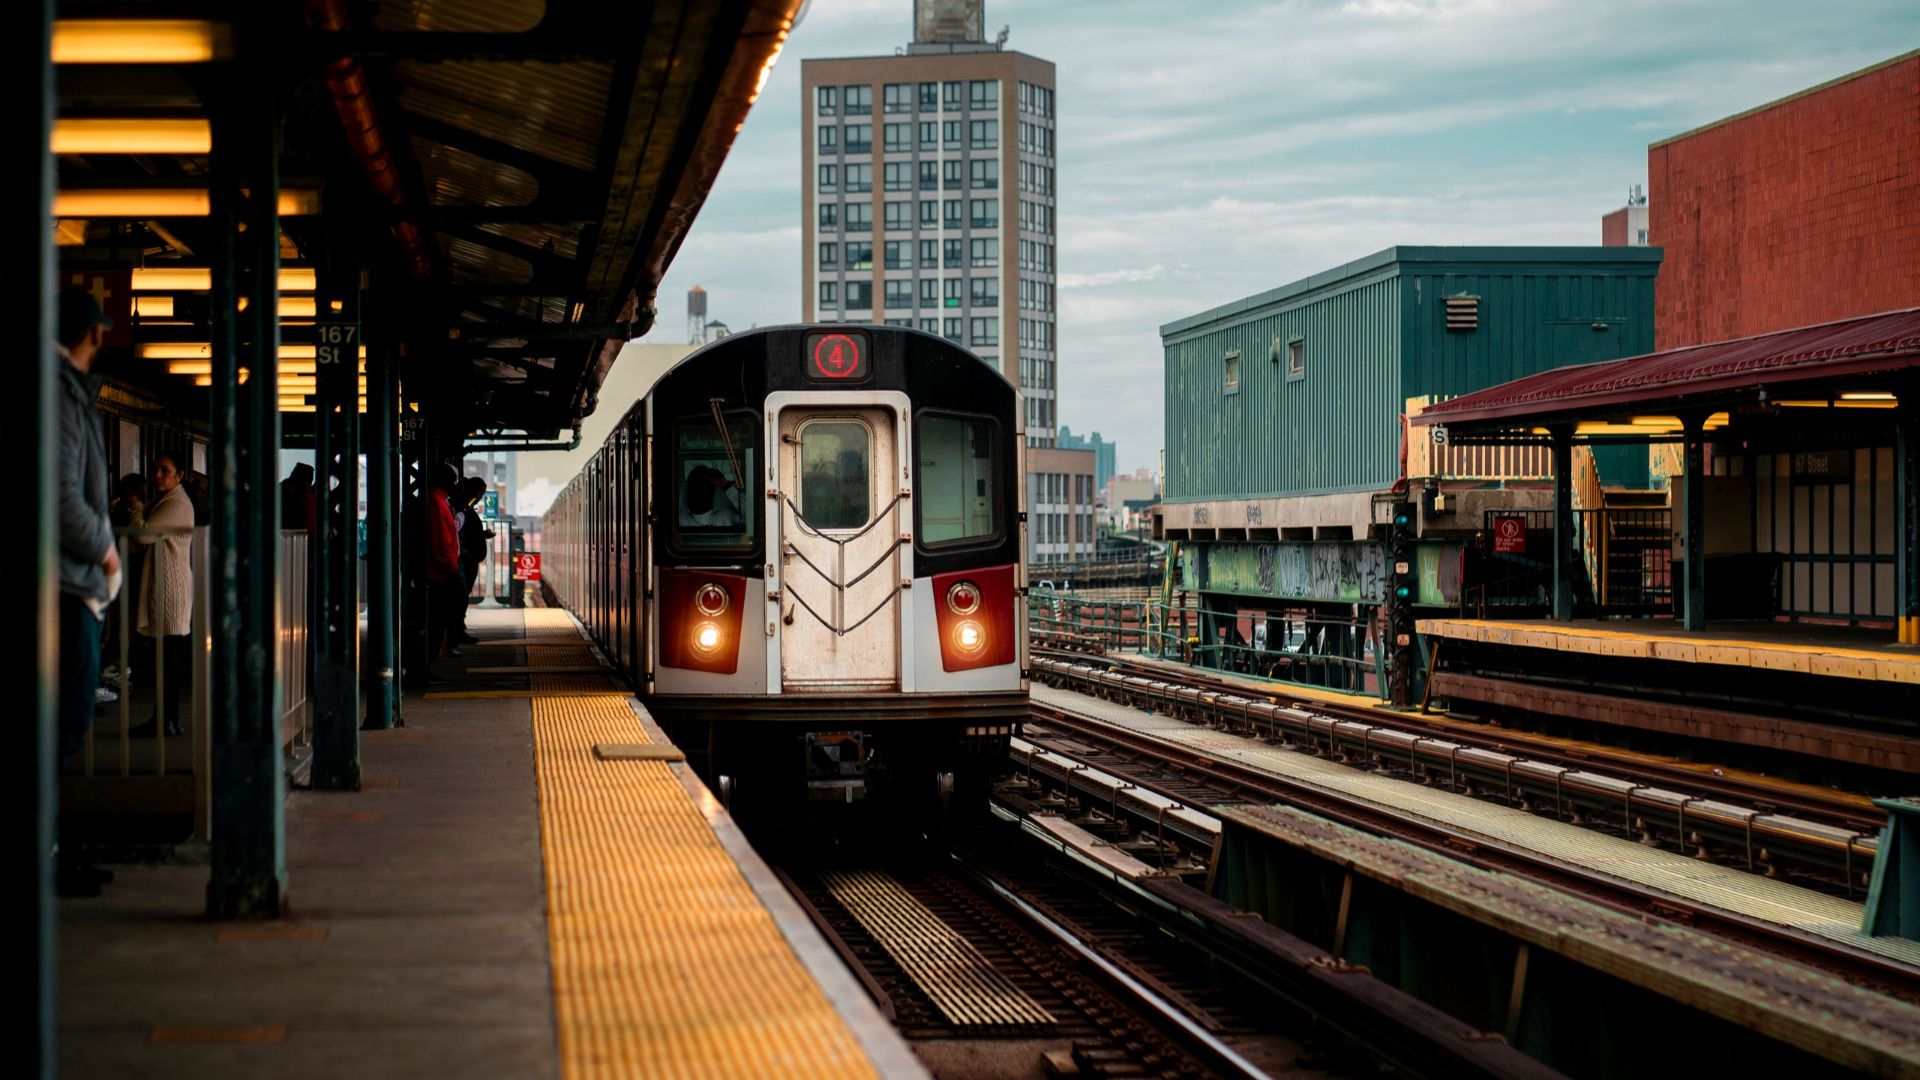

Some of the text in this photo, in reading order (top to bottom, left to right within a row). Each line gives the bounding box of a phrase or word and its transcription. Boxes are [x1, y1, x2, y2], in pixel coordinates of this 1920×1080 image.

[319, 326, 356, 344] 167
[318, 346, 340, 364] St
[829, 343, 844, 369] 4
[403, 418, 425, 429] 167
[403, 430, 417, 441] St
[1435, 430, 1445, 443] S
[1807, 453, 1828, 473] Street
